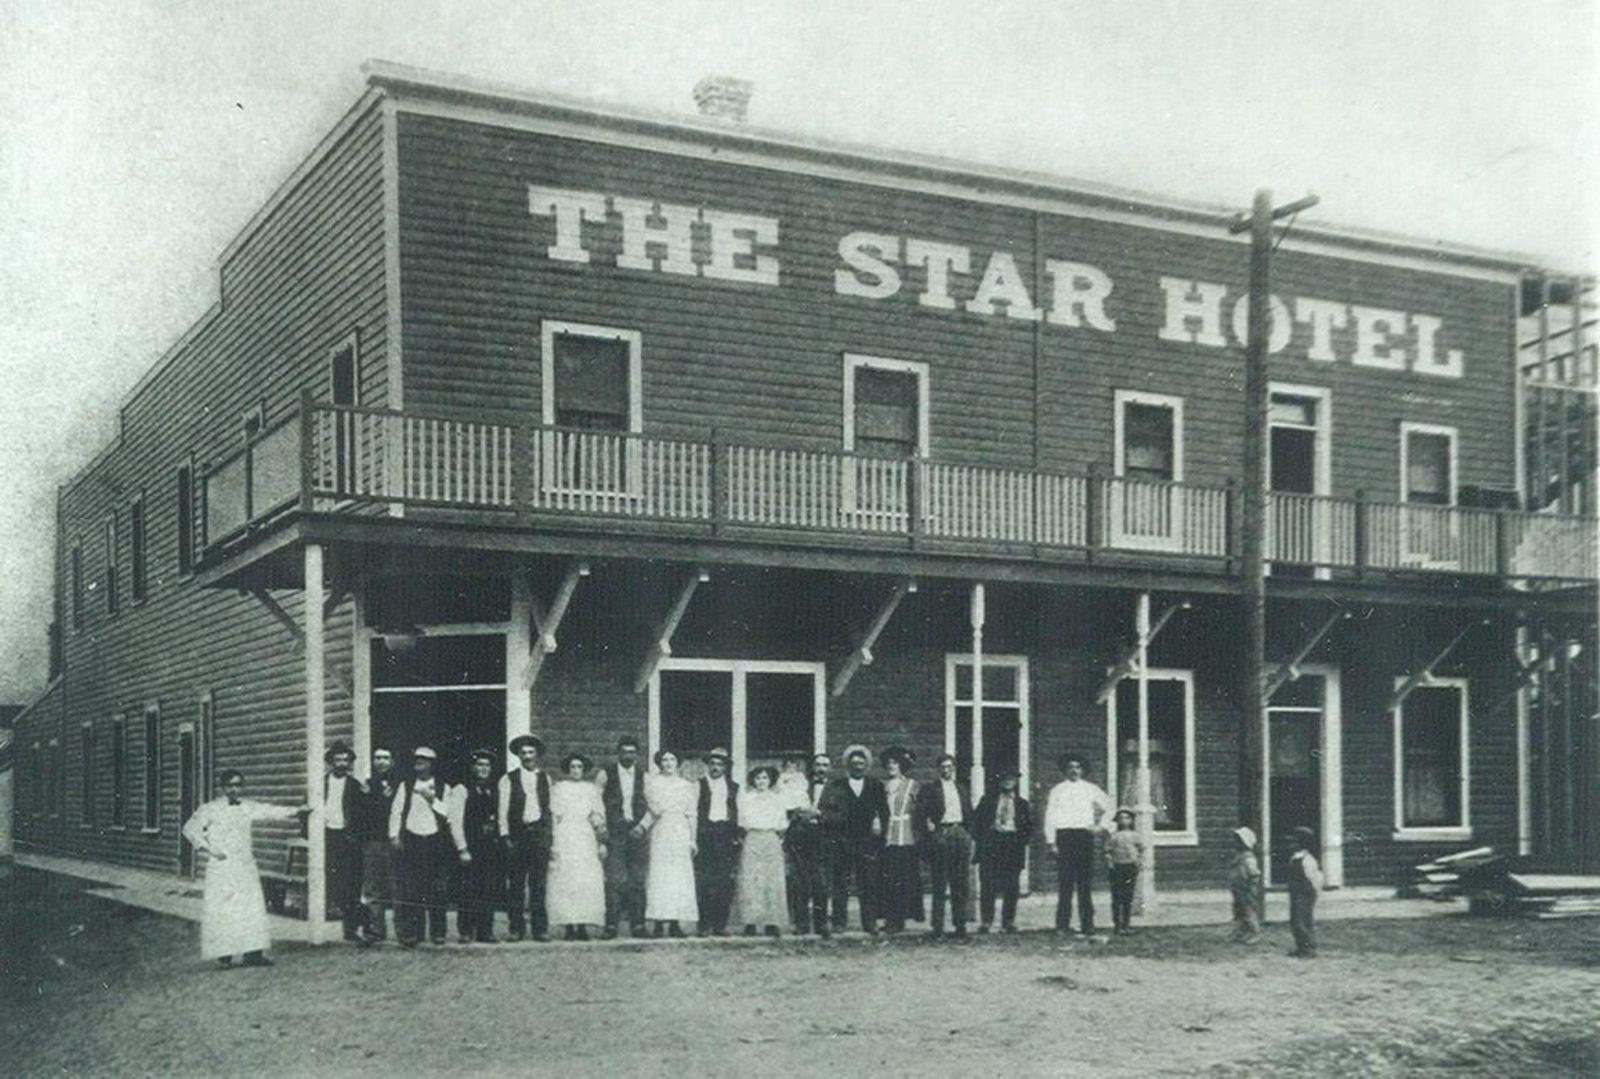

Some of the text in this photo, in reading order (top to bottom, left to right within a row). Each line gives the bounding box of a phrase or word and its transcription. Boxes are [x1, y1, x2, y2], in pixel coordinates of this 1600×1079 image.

[528, 184, 1463, 378] THE STAR HOTEL
